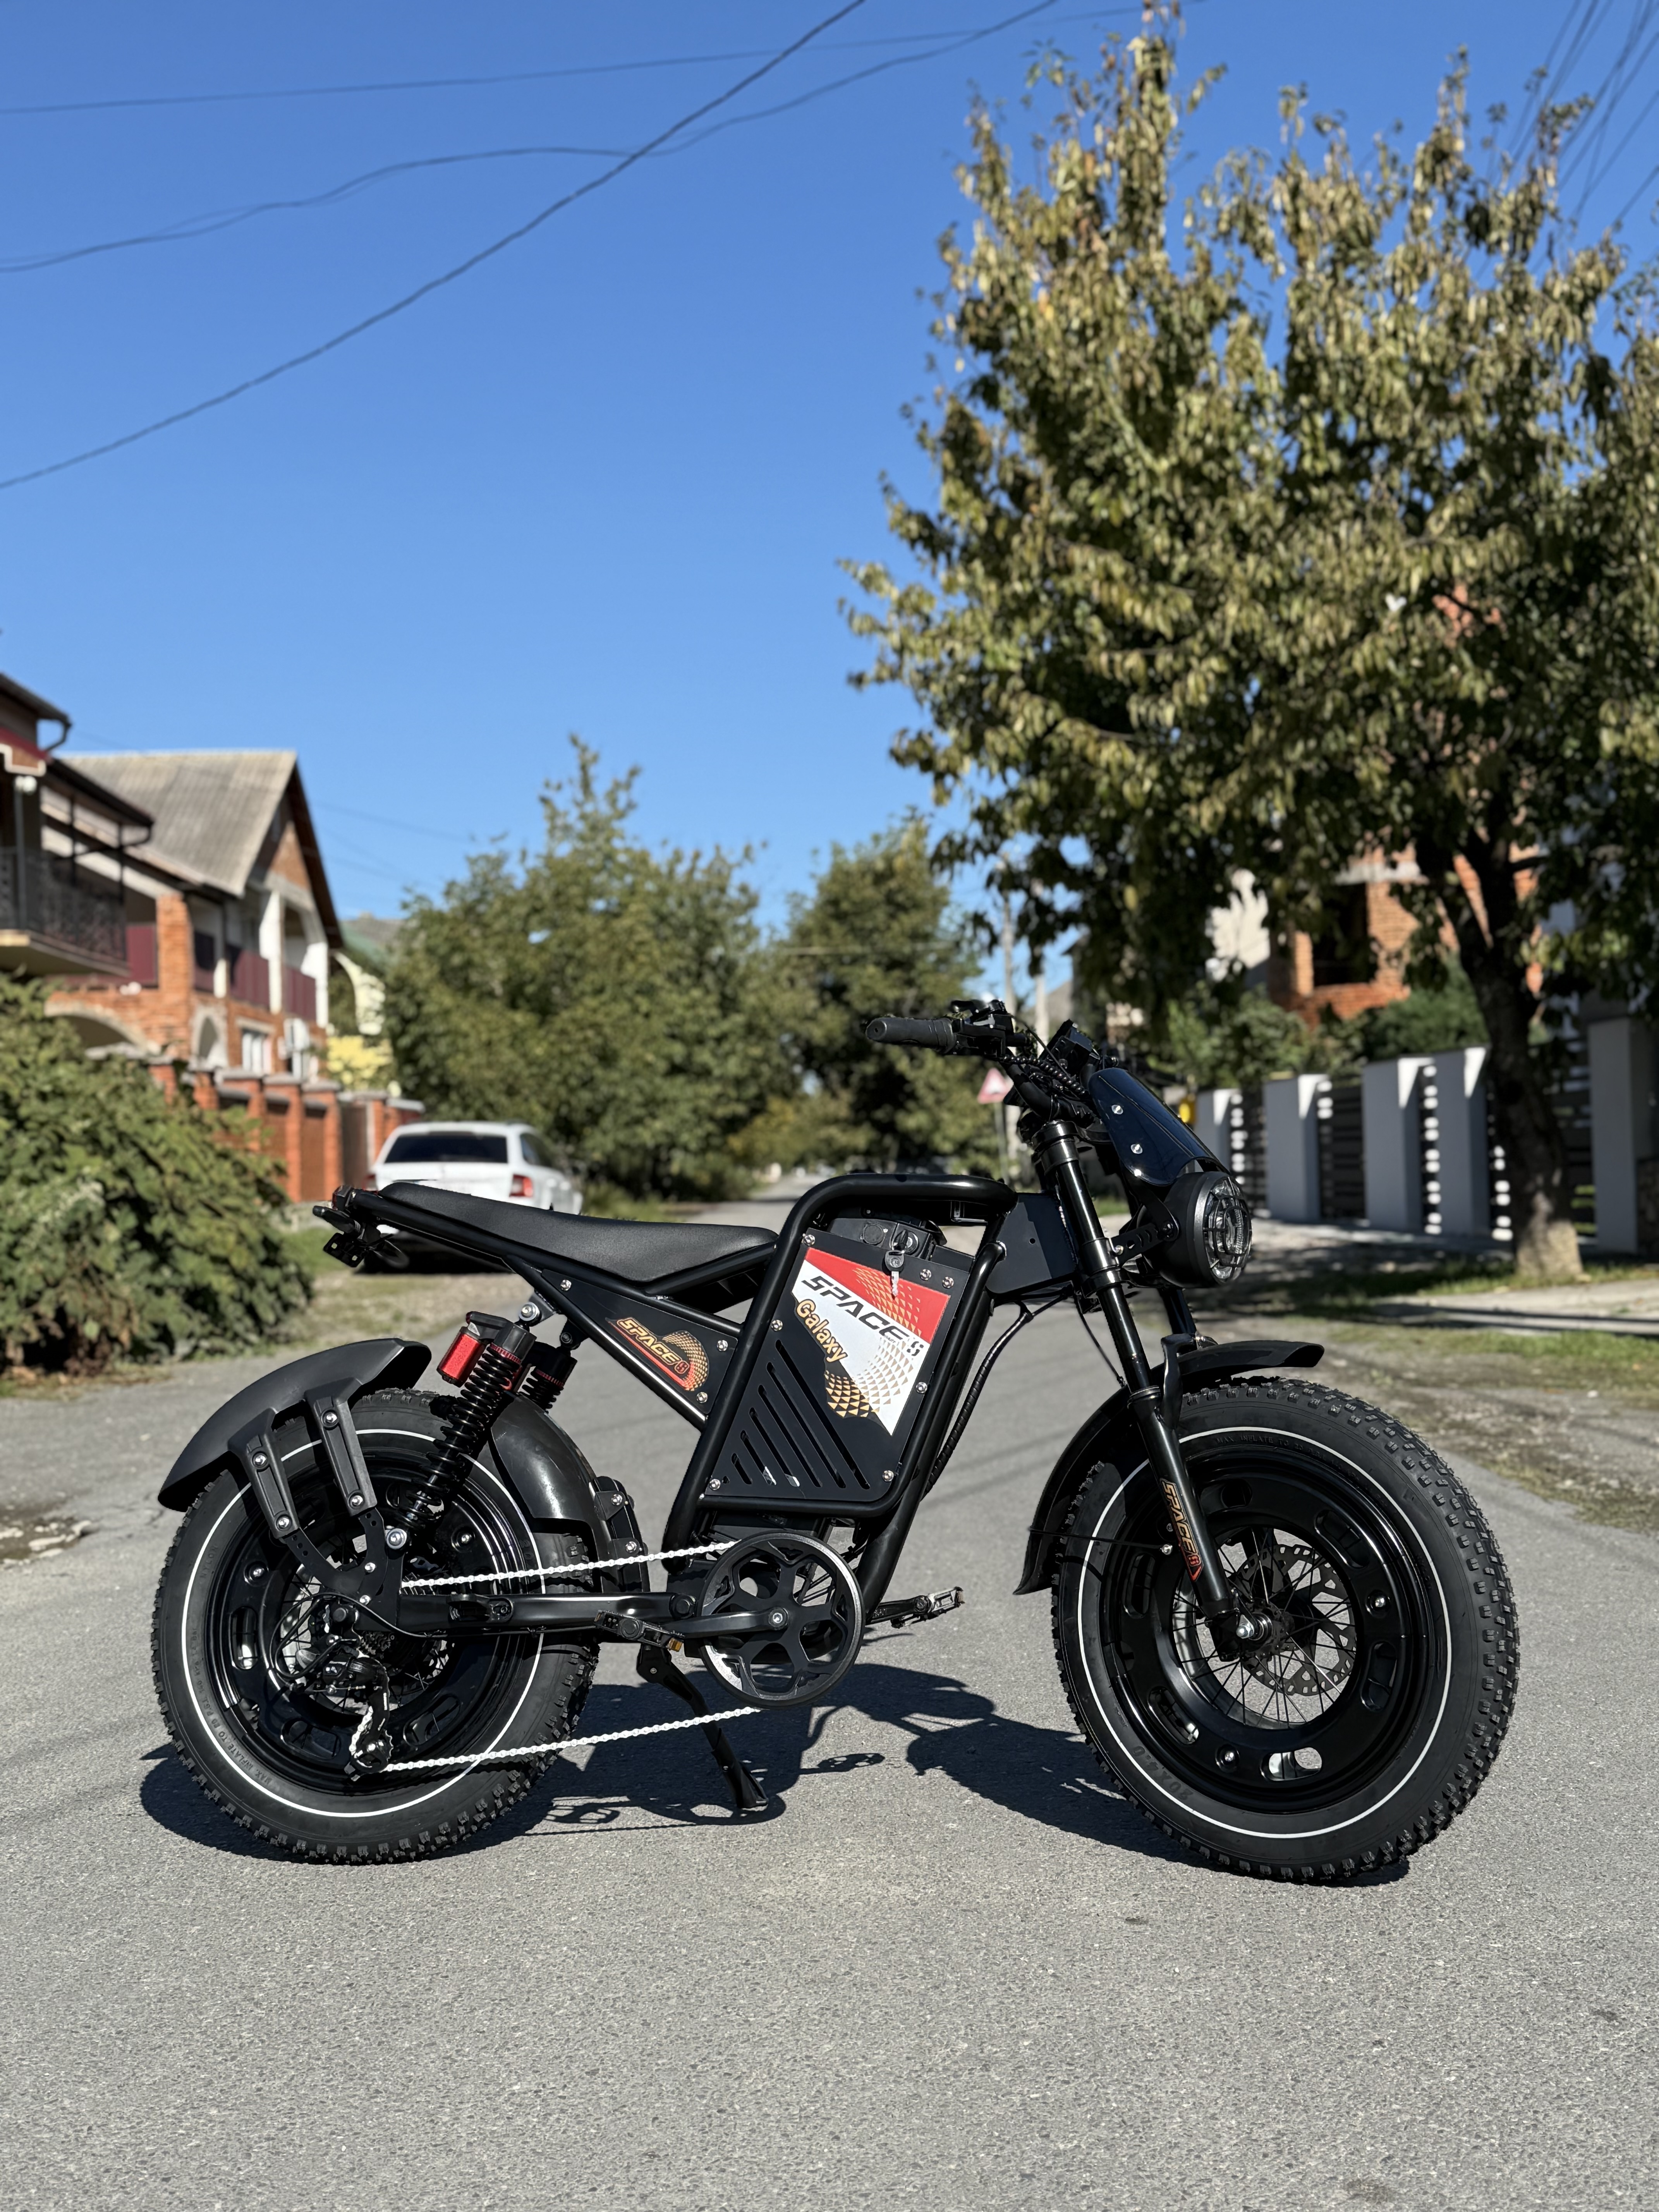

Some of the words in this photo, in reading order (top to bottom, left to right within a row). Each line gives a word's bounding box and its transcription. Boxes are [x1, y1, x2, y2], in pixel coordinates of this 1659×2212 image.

[796, 1298, 848, 1363] Galaxy
[801, 1276, 910, 1340] SPACE
[619, 1319, 680, 1364] SPACE
[1162, 1480, 1197, 1554] SPACE
[218, 1730, 229, 1742] TO
[227, 1743, 254, 1770] INFLATE
